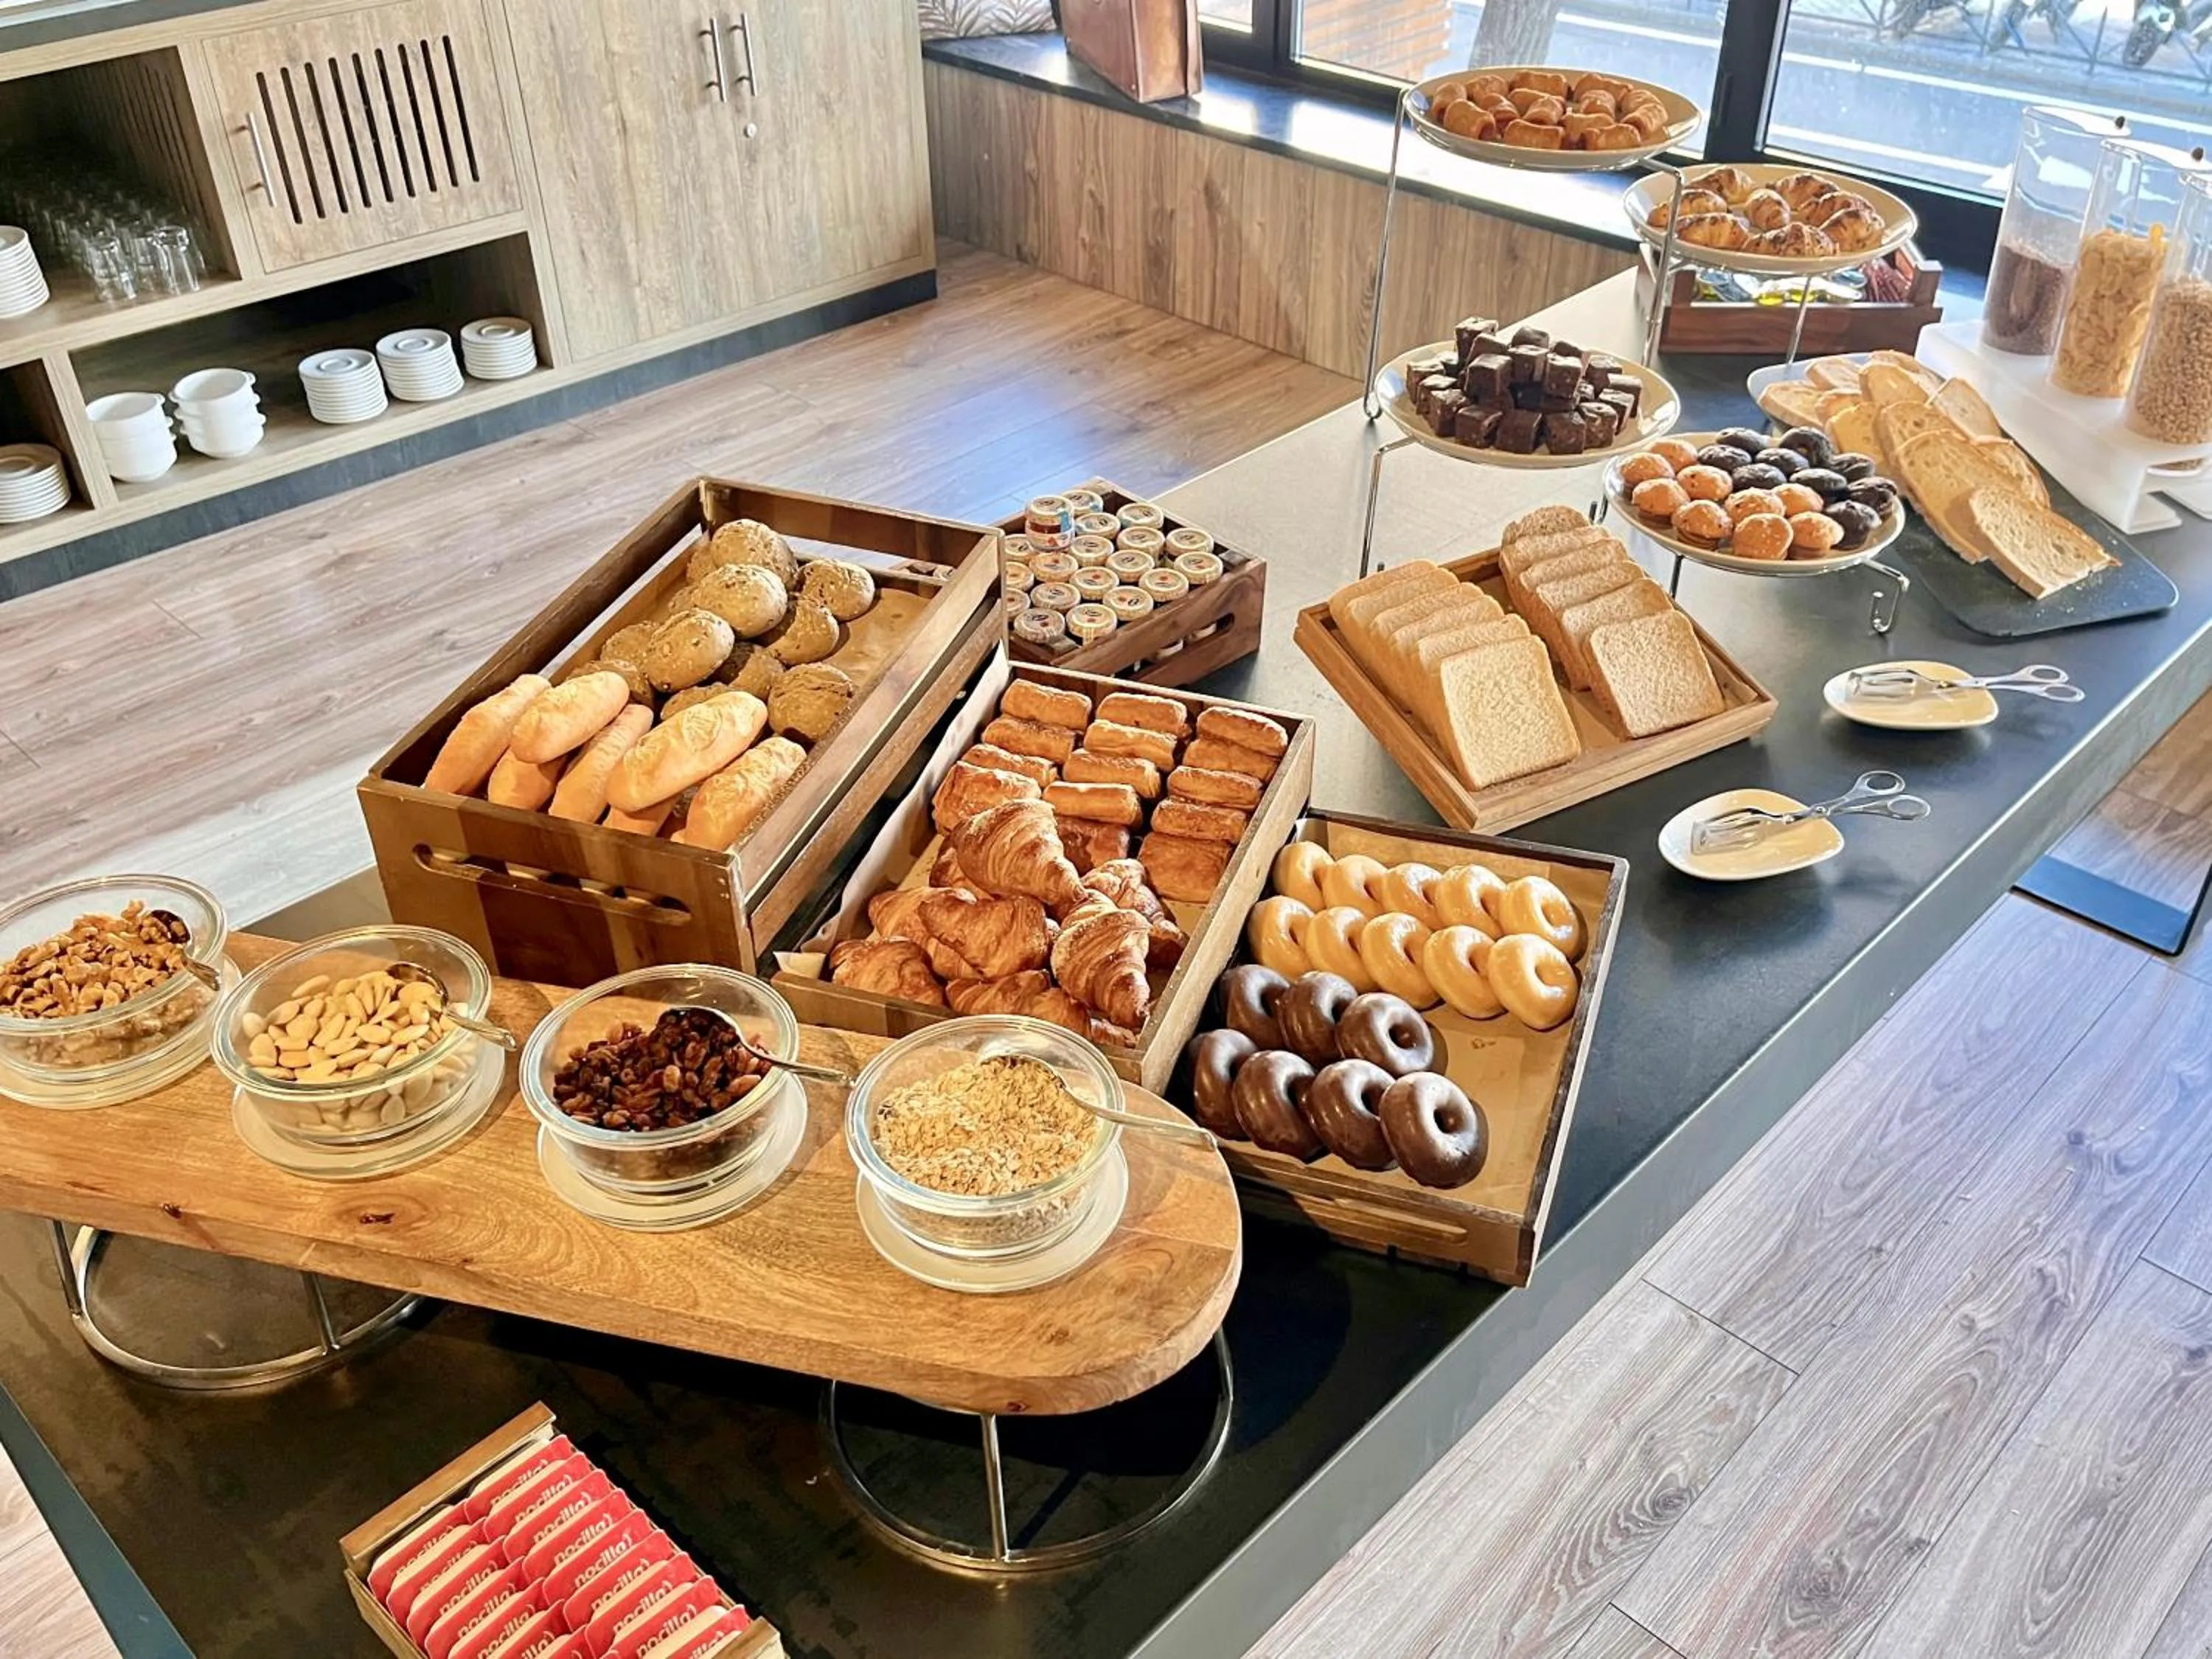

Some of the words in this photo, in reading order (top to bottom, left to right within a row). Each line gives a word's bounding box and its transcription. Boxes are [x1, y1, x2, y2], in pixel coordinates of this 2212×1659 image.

[534, 1498, 587, 1543] nocilla
[554, 1520, 606, 1565] nocilla
[574, 1540, 627, 1587] nocilla
[439, 1566, 492, 1615] nocilla
[591, 1565, 644, 1610] nocilla
[613, 1587, 666, 1634] nocilla
[457, 1590, 510, 1638] nocilla
[478, 1612, 529, 1659] nocilla
[636, 1610, 690, 1658] nocilla
